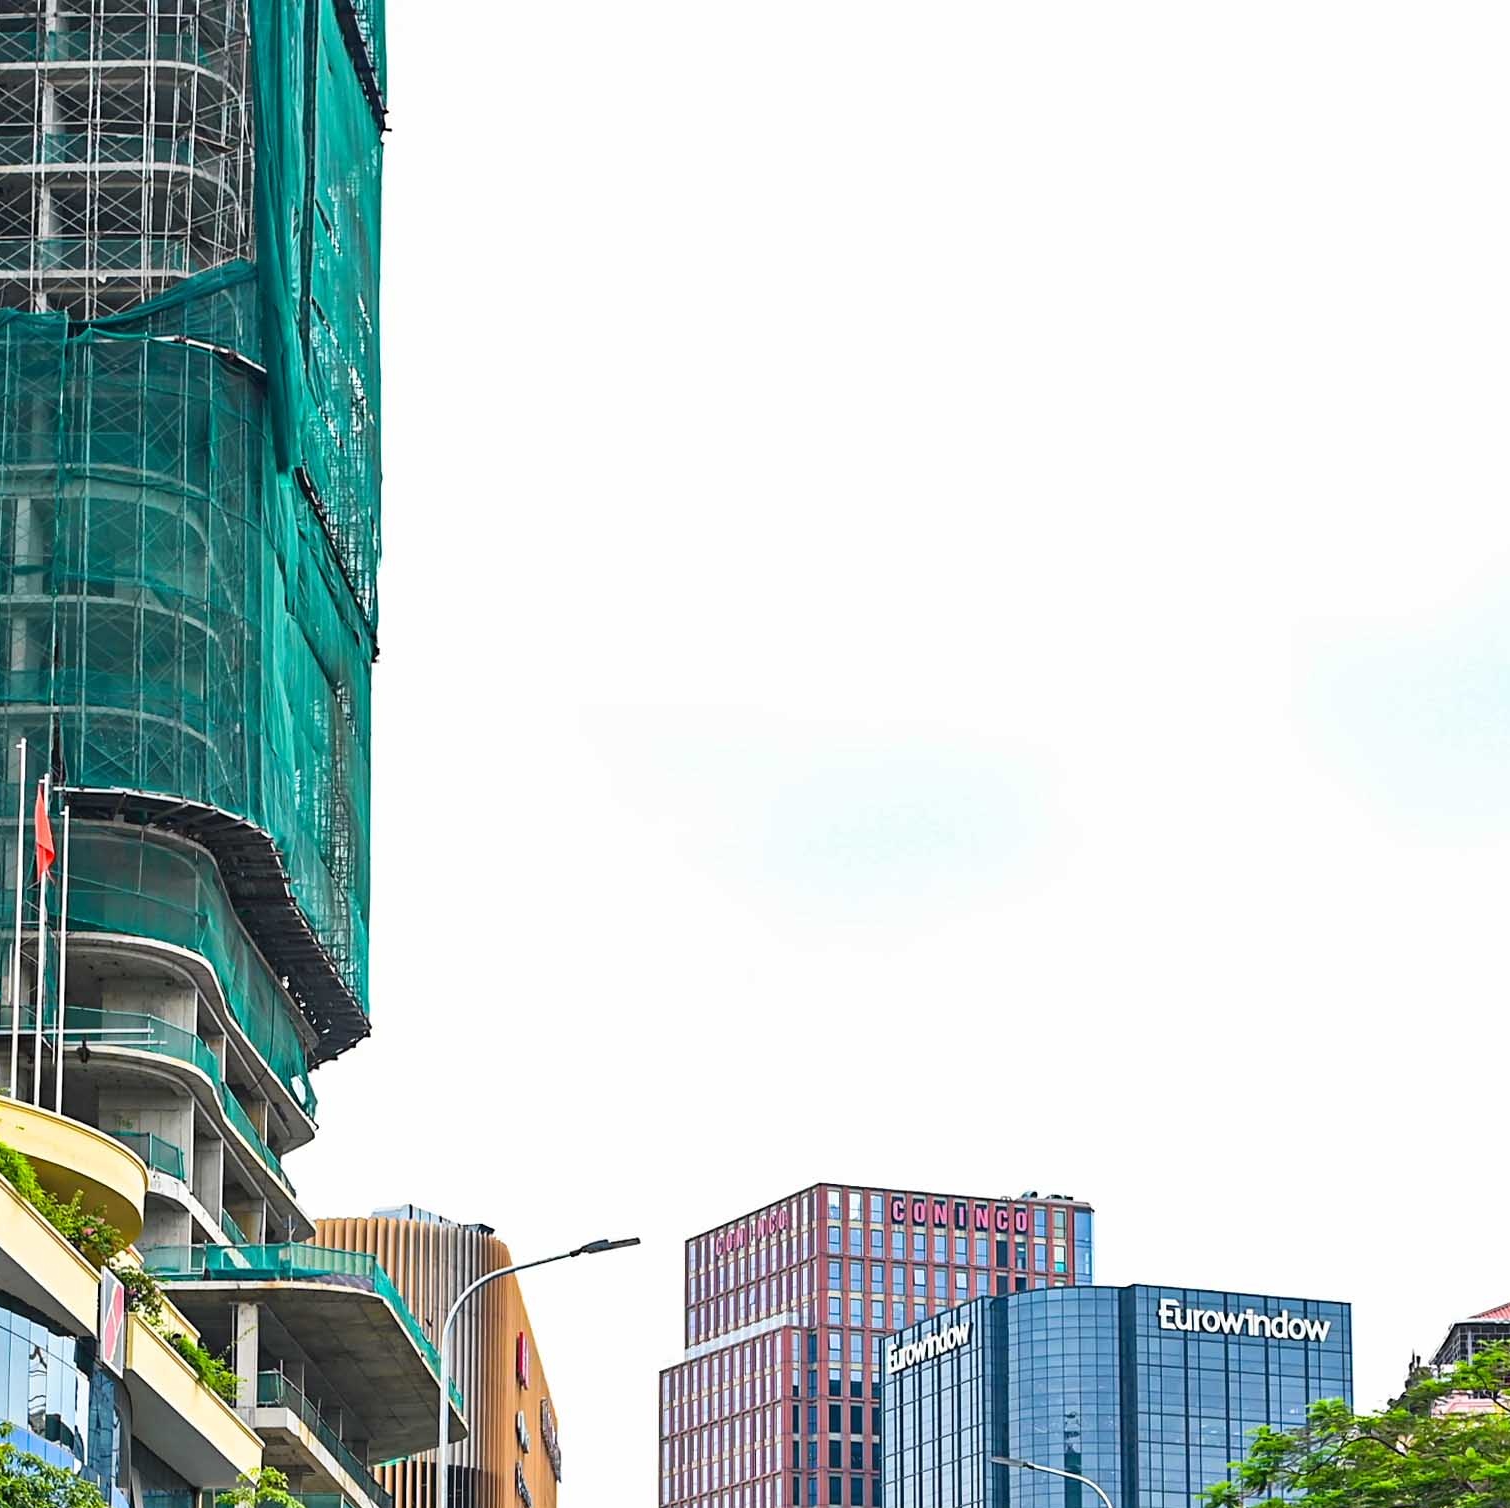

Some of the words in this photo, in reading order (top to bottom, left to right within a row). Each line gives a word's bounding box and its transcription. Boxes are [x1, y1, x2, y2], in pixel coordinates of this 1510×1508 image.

[893, 1200, 1028, 1232] CONINCO
[1158, 1298, 1331, 1343] Eurowindow
[886, 1321, 973, 1374] Eurowindow
